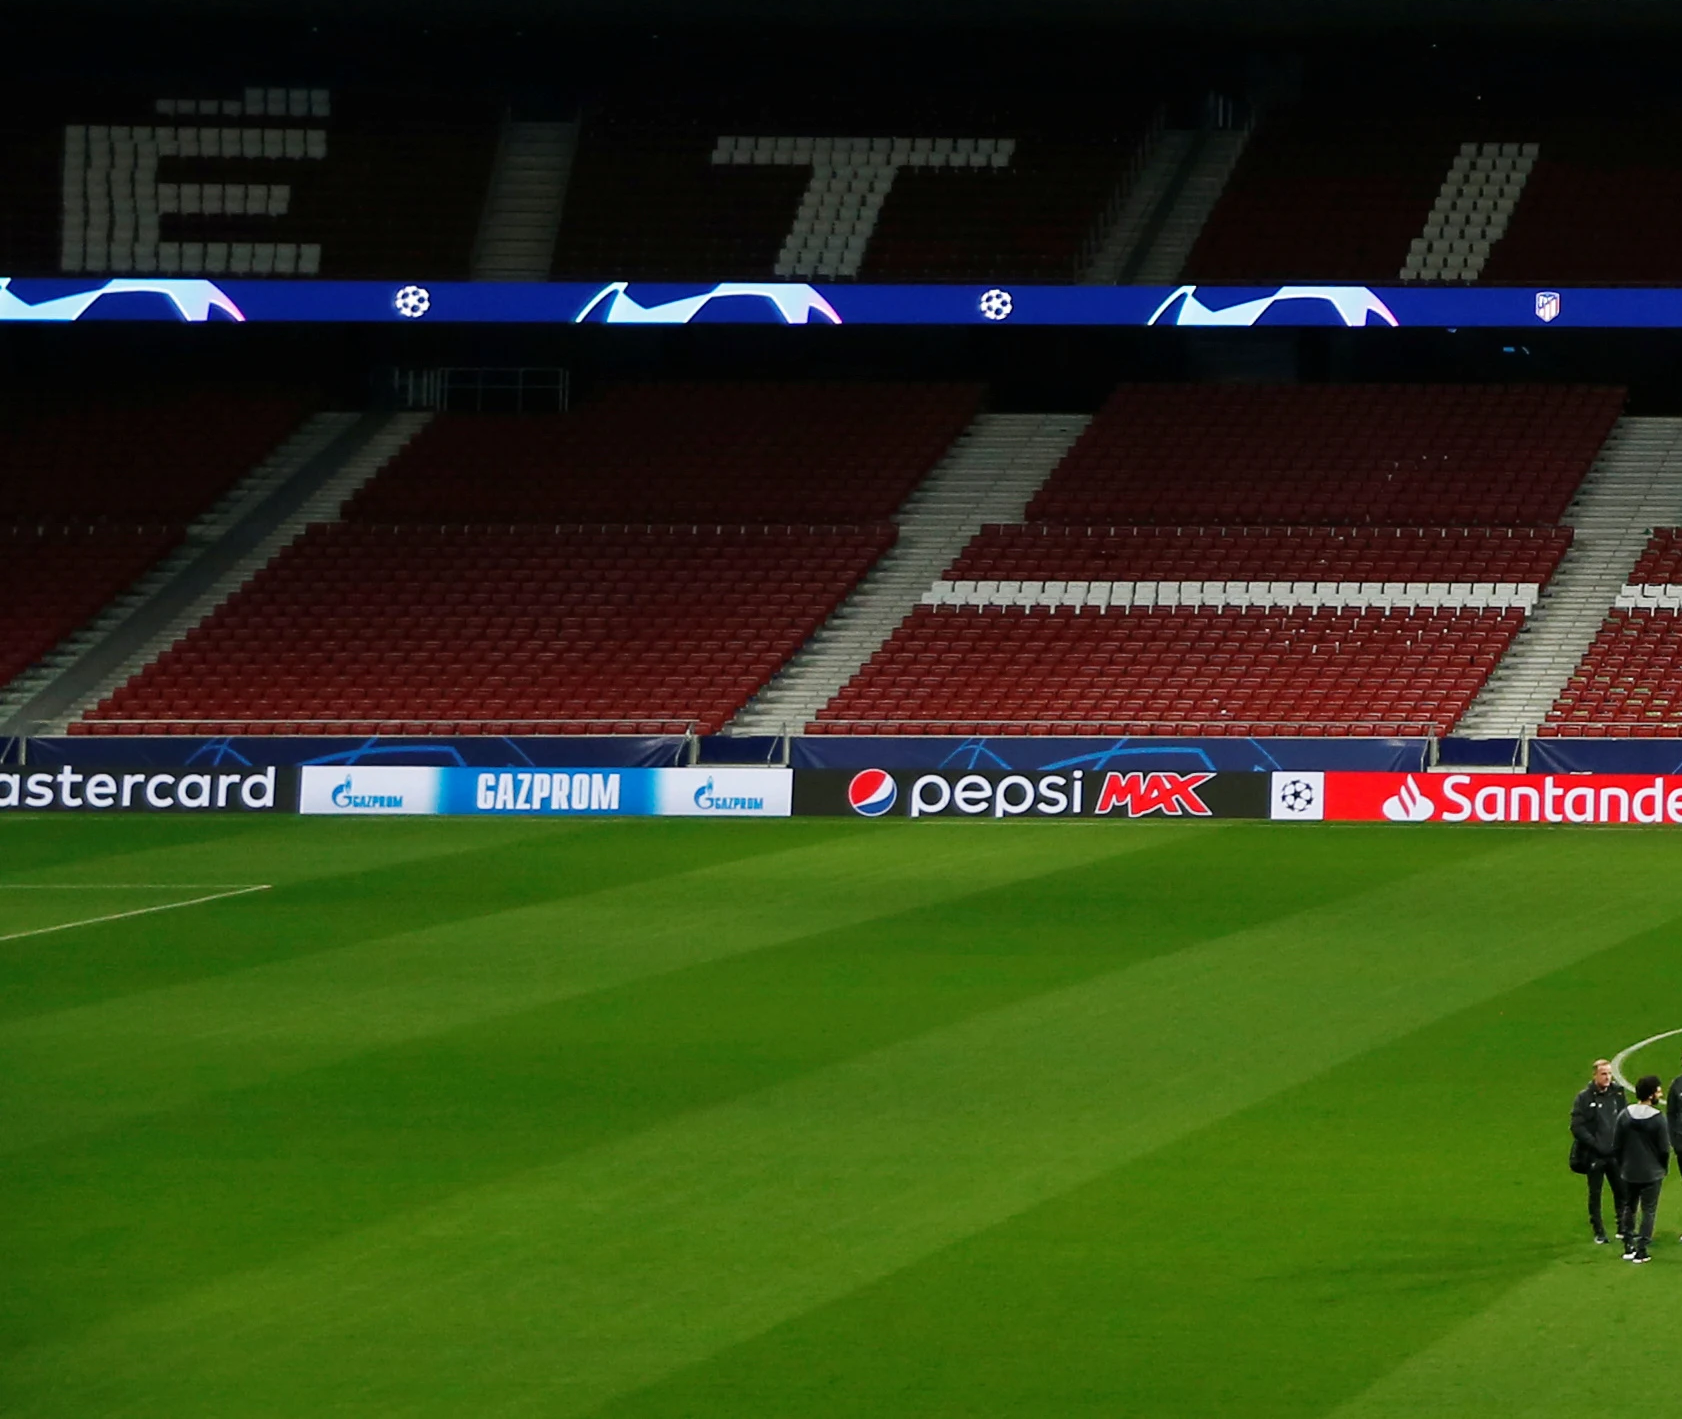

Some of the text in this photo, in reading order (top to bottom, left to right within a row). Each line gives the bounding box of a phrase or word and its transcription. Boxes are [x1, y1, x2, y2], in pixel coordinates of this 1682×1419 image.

[476, 773, 620, 810] GAZPROM
[911, 770, 1218, 818] pepsi MAX
